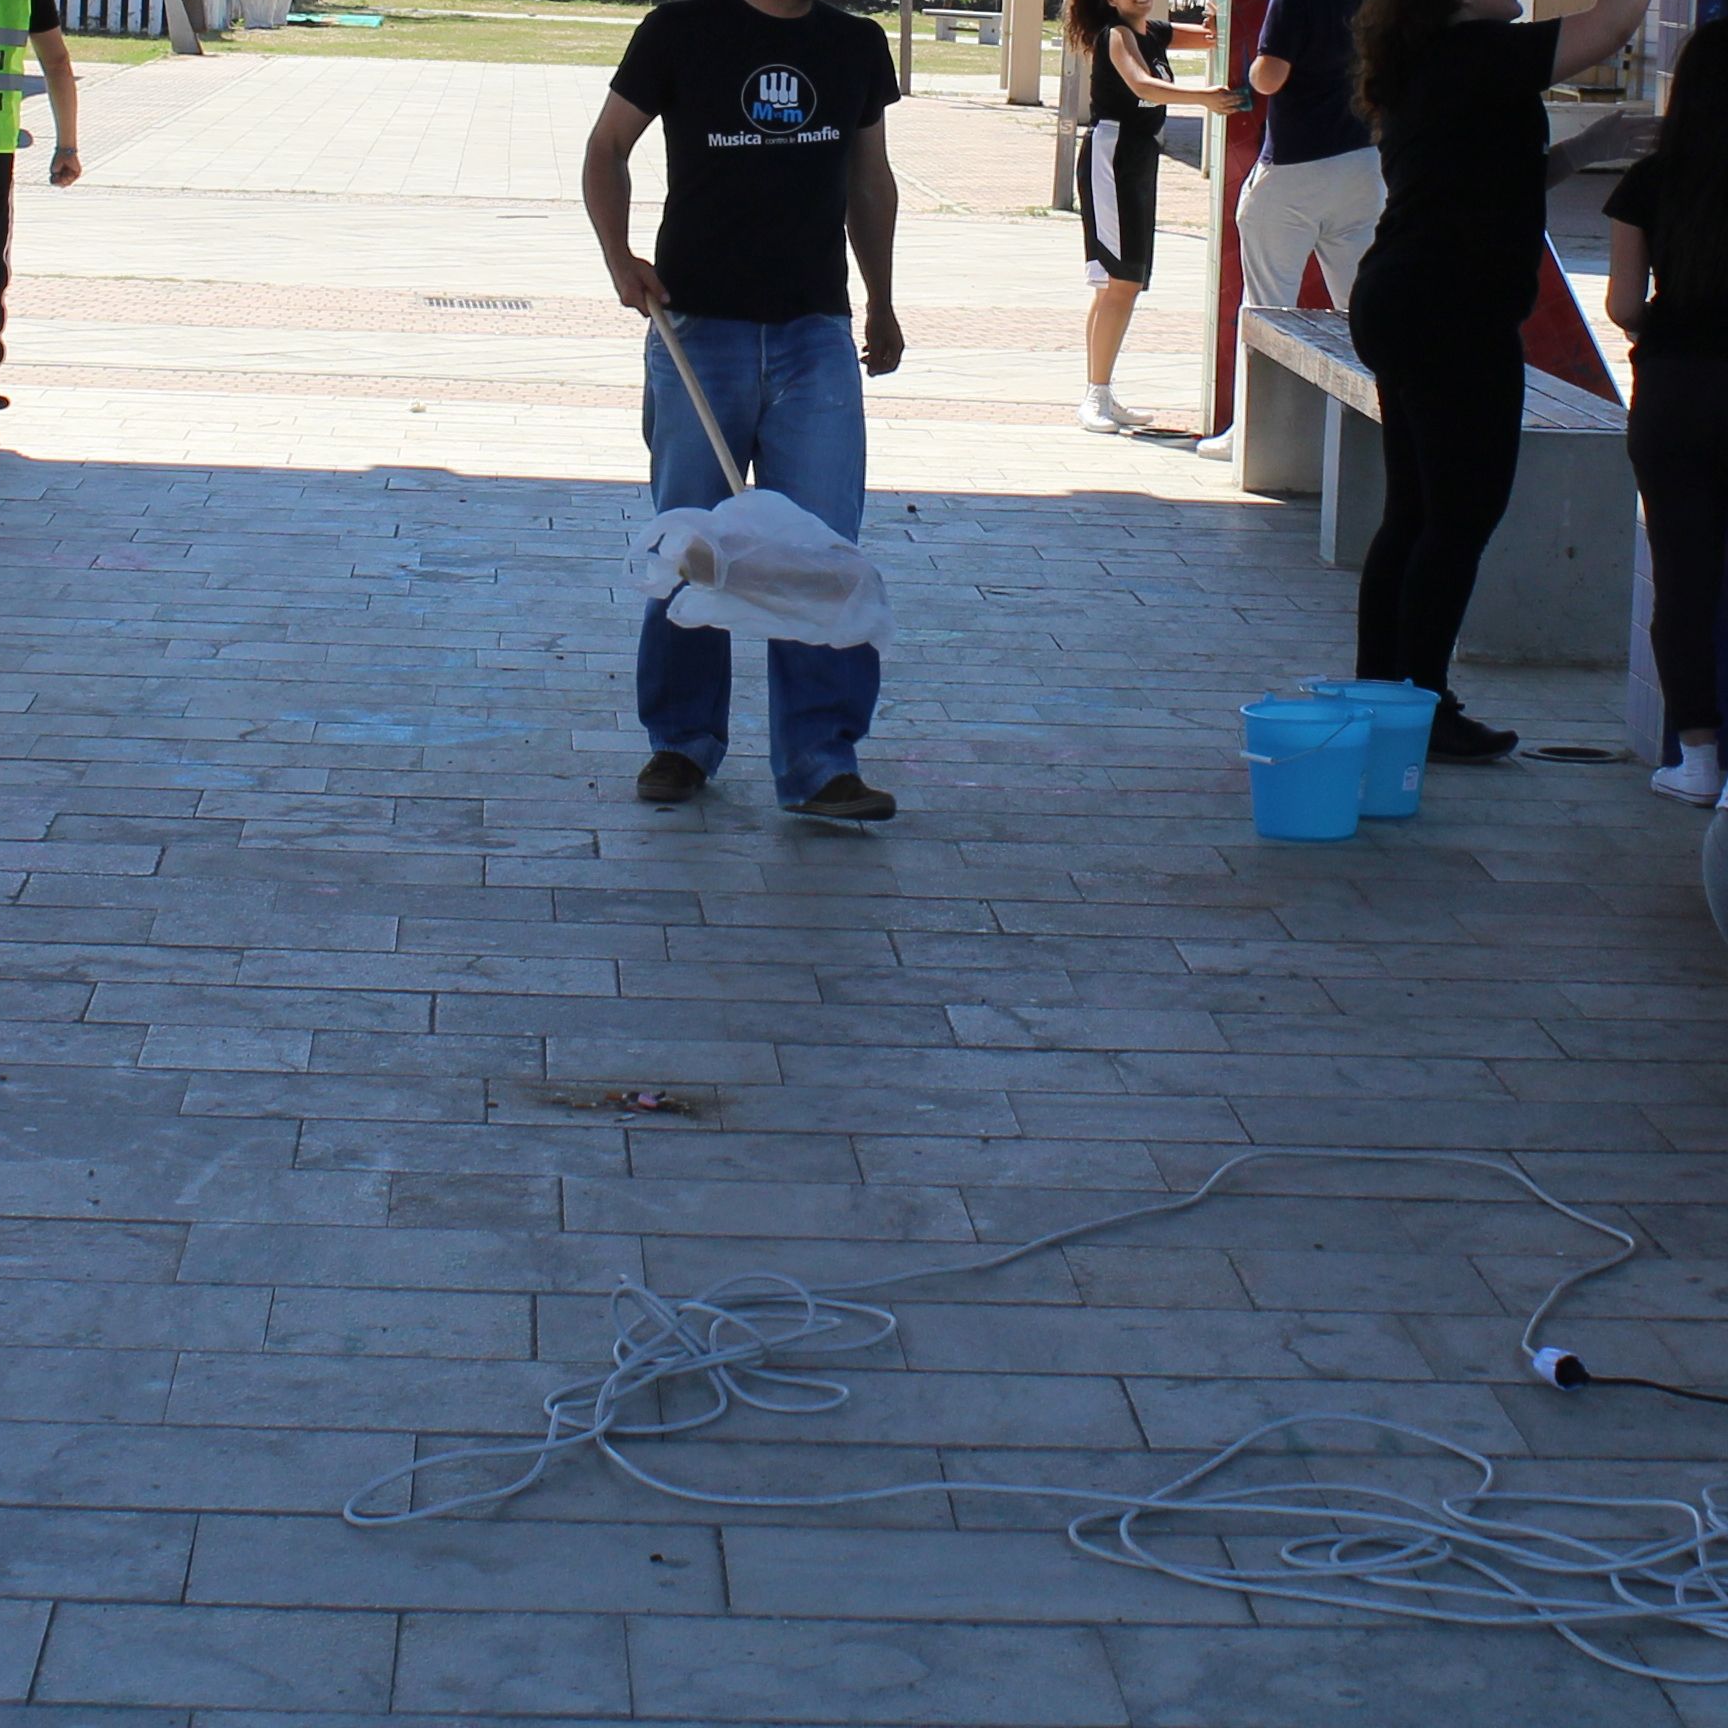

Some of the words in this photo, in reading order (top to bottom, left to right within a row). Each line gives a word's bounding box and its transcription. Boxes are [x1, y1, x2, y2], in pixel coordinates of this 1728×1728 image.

[707, 130, 762, 147] Musica
[765, 136, 788, 145] contro
[797, 125, 840, 144] mafie
